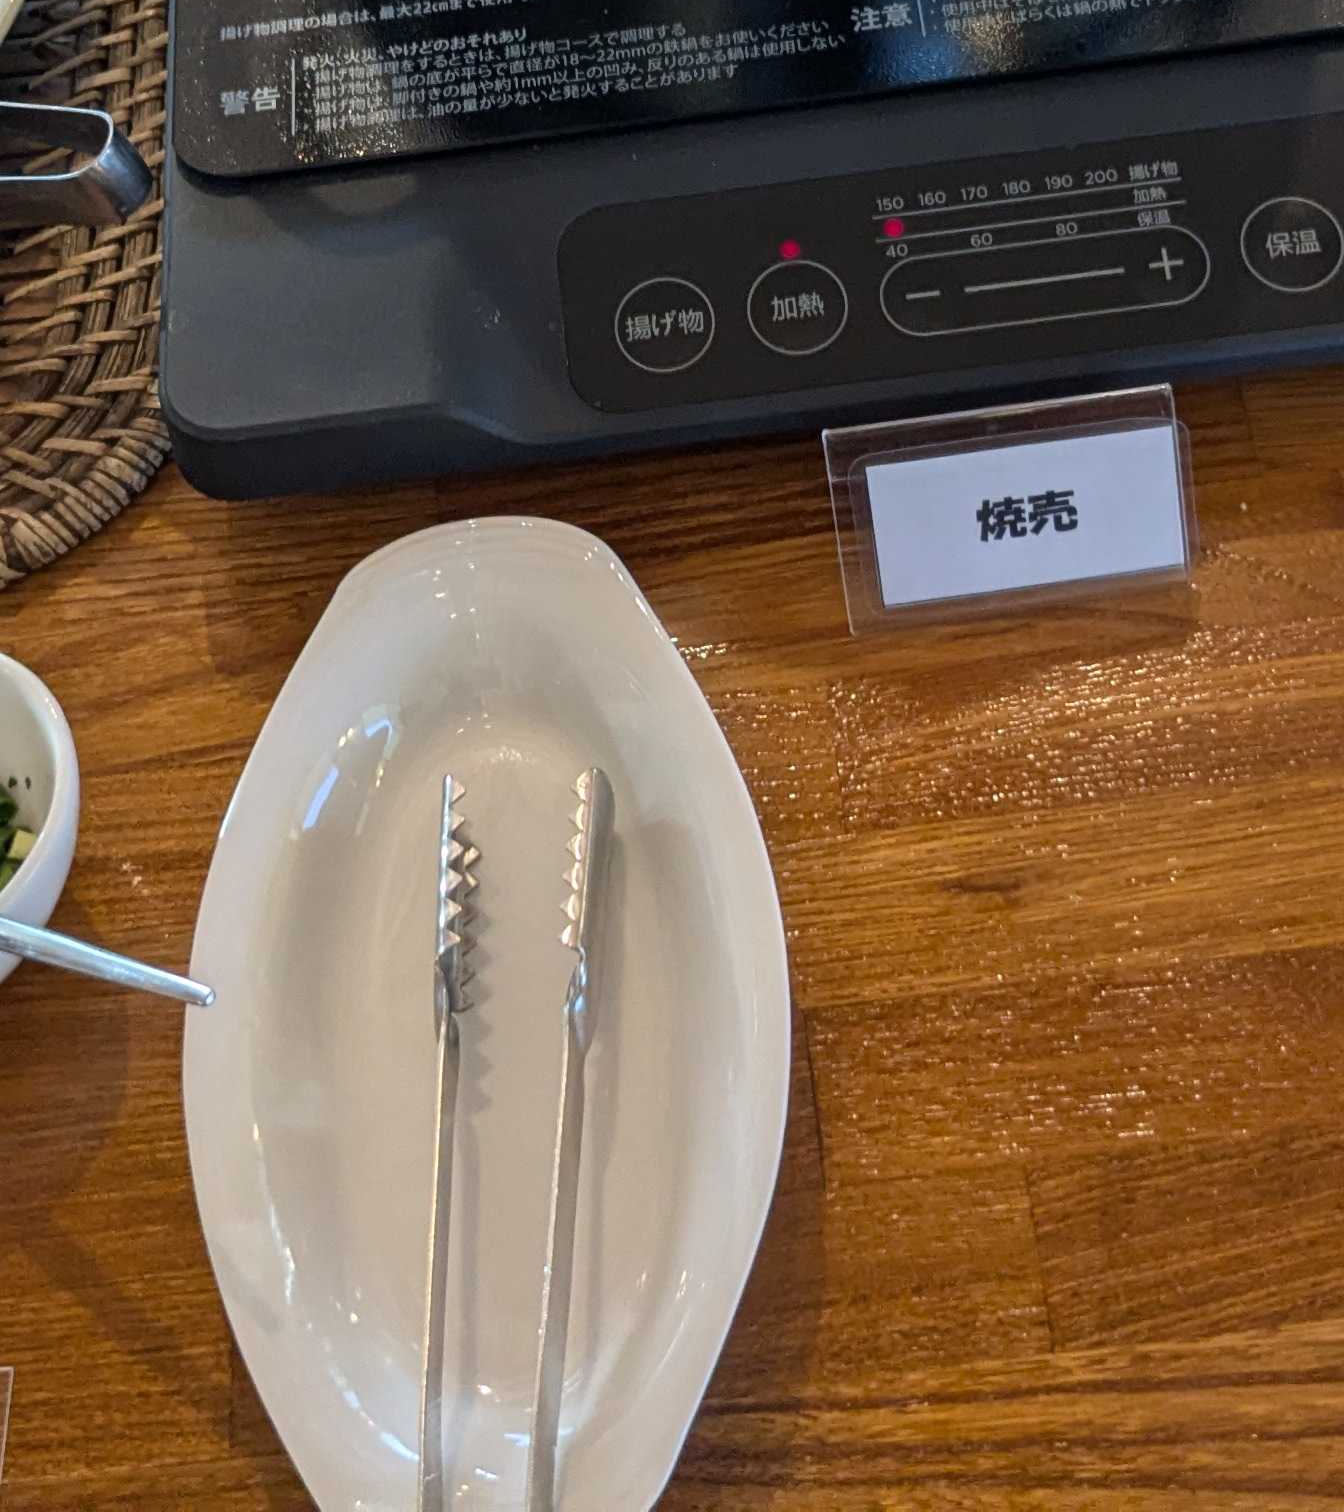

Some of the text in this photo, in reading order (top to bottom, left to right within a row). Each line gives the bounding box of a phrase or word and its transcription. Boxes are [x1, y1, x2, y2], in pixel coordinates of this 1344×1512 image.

[850, 0, 914, 33] 注意
[219, 85, 282, 117] 警告
[876, 195, 904, 212] 150
[918, 190, 947, 207] 160
[960, 185, 989, 202] 170
[1001, 180, 1031, 197] 180
[1044, 175, 1074, 191] 190
[1084, 168, 1119, 186] 200
[1132, 185, 1168, 204] 加熱
[885, 243, 910, 259] 40
[970, 232, 994, 248] 60
[1055, 221, 1079, 237] 80
[1264, 226, 1324, 259] 保温
[768, 290, 827, 323] 加熱
[624, 308, 707, 342] 揚げ物
[976, 489, 1079, 543] 焼売
